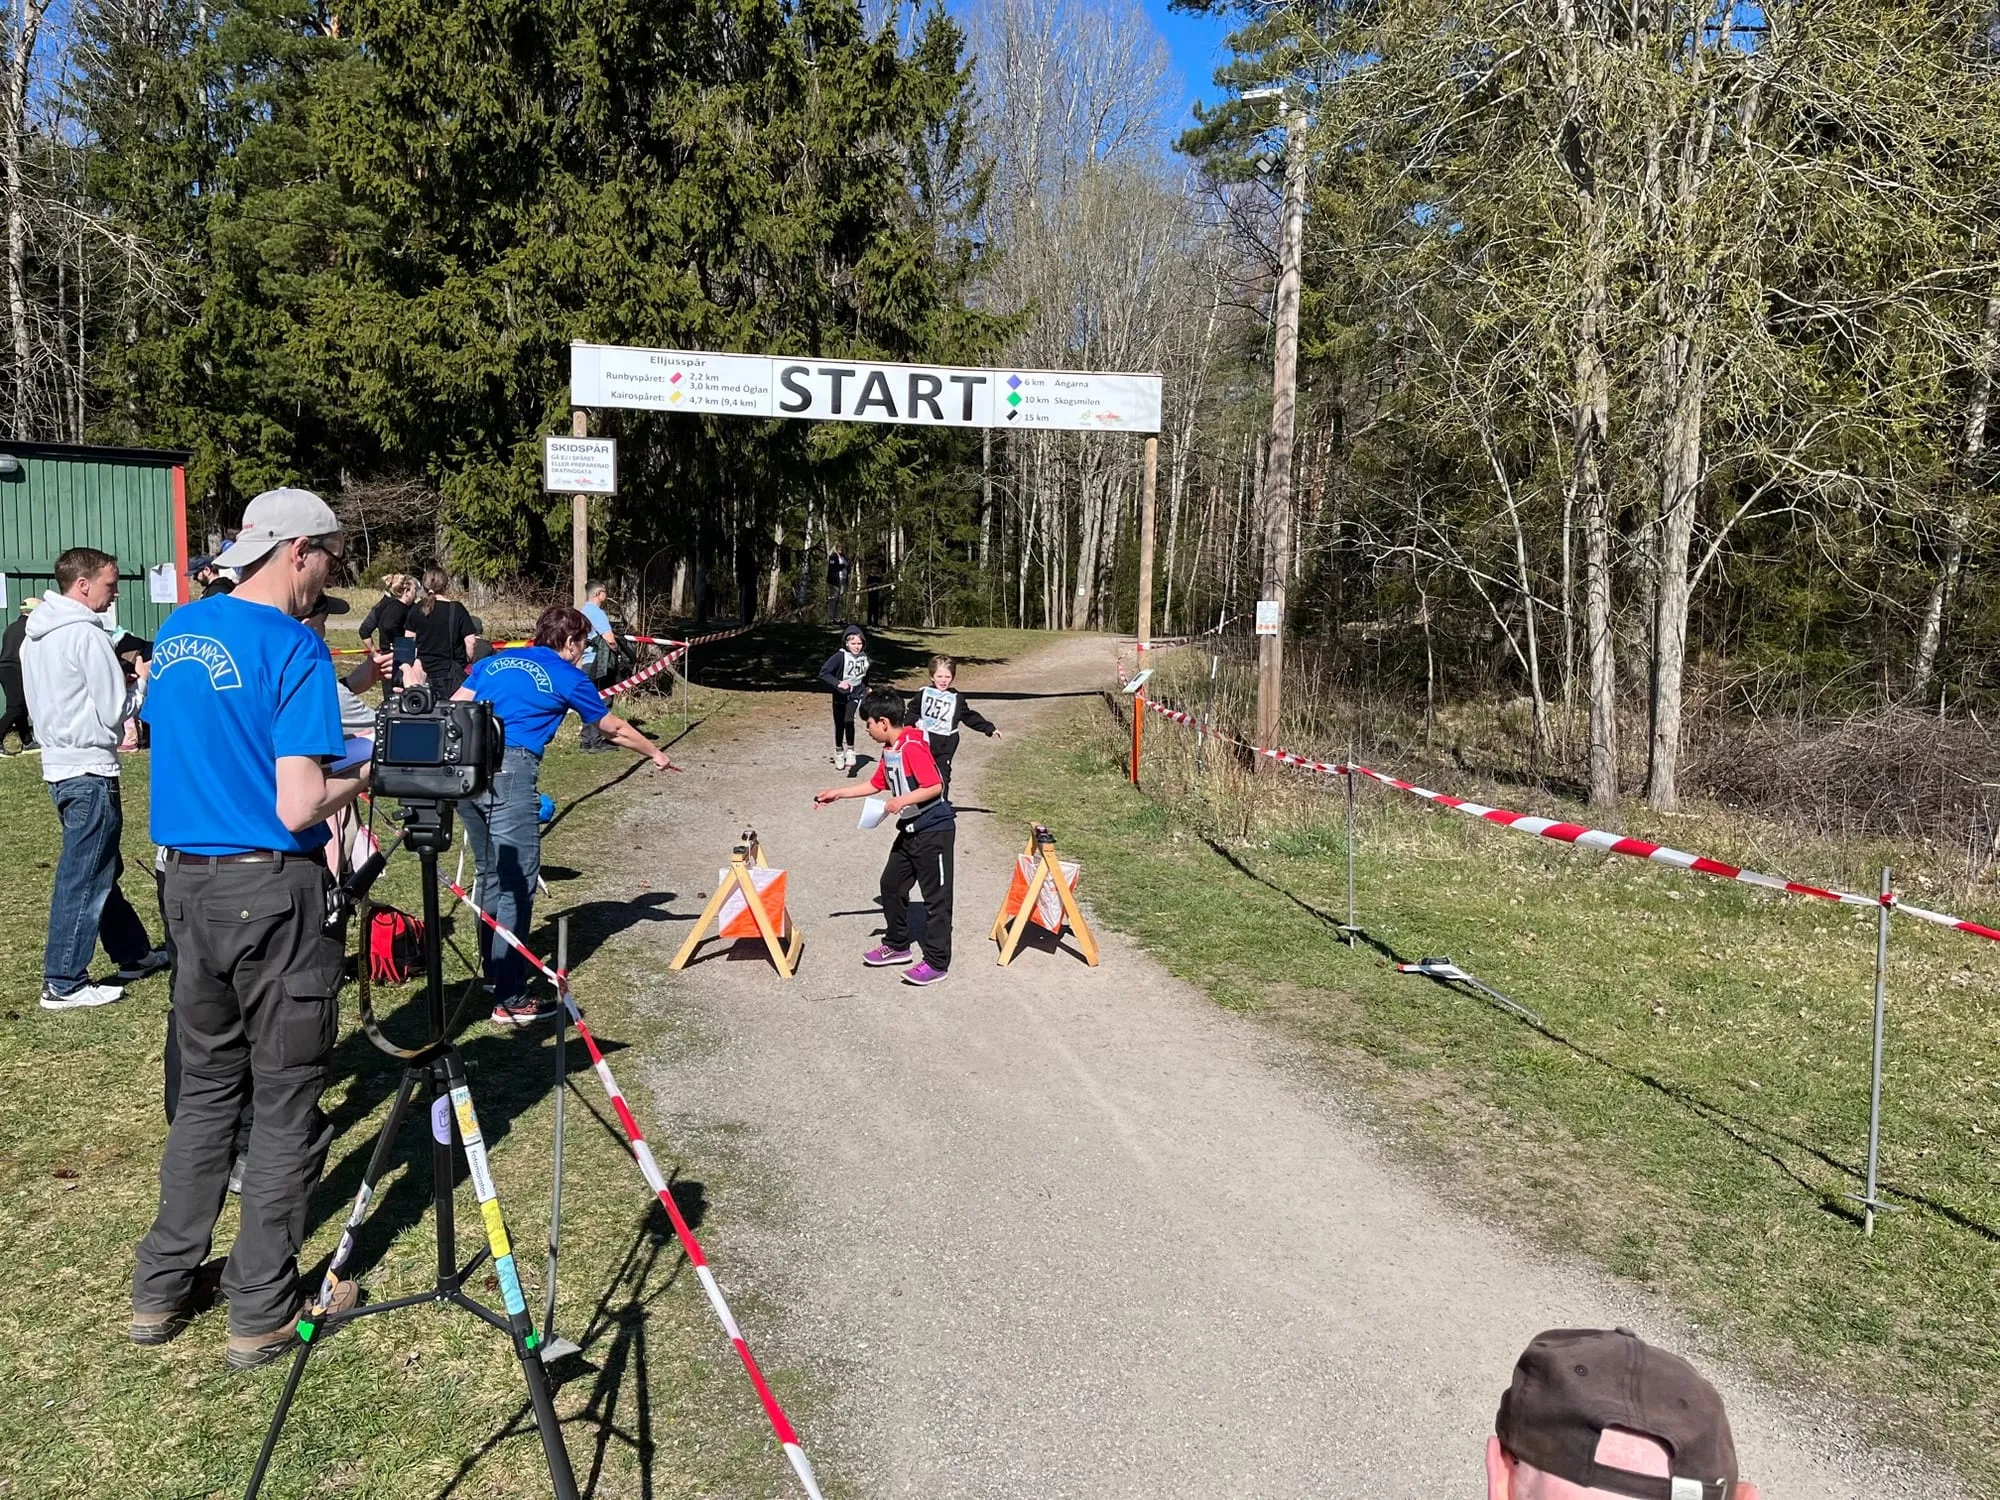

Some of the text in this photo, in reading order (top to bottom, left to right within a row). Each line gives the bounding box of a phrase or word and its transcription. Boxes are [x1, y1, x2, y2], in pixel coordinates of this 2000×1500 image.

[650, 355, 706, 367] Elljusspår
[606, 371, 665, 383] Runbyspåret:
[689, 372, 719, 382] 2,2 km
[1032, 378, 1045, 387] km
[689, 382, 769, 395] 3,0 km med Öglan
[779, 365, 987, 422] START
[610, 391, 665, 402] Kairospåret:
[689, 396, 757, 409] 4,7 km (9,4 km)
[1025, 396, 1050, 404] 10 km
[1054, 397, 1101, 407] Skogsmilen
[1025, 413, 1050, 421] 15 km
[551, 442, 609, 454] SKIDSPÅR
[925, 696, 952, 722] 252
[885, 766, 902, 798] 51
